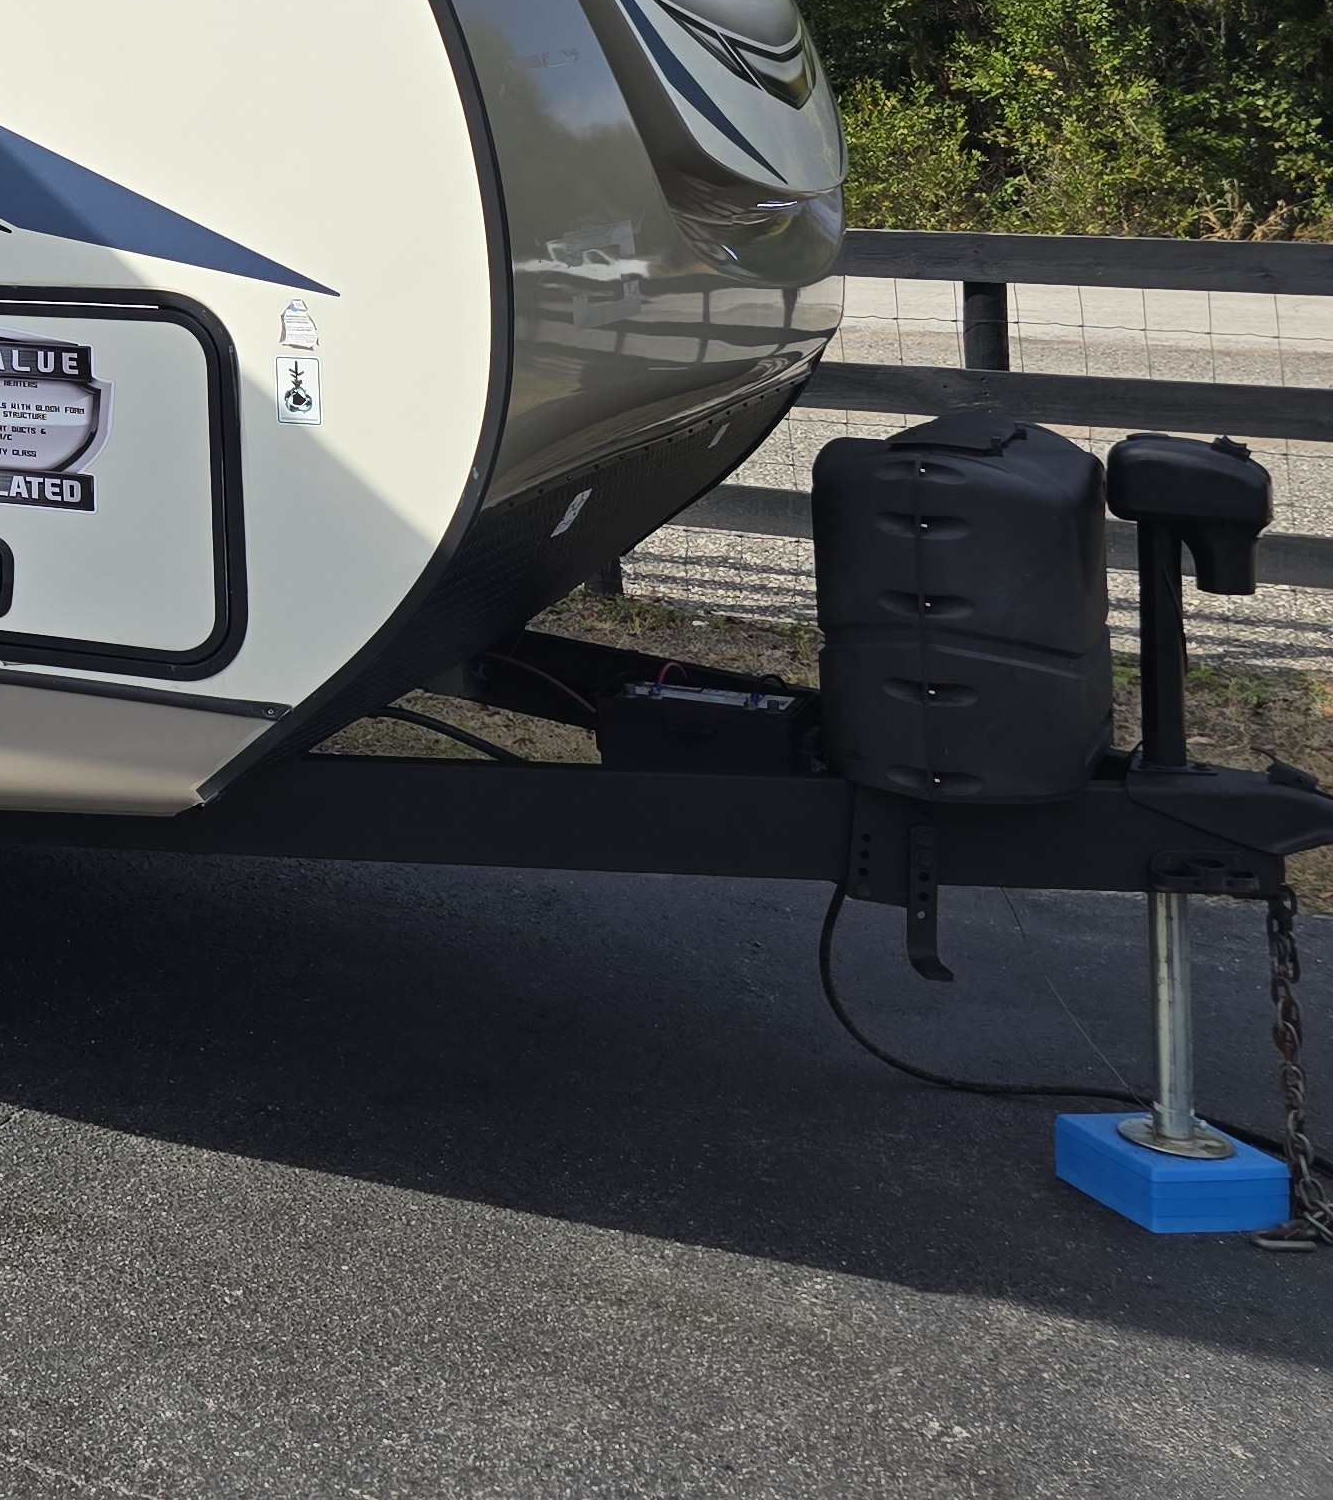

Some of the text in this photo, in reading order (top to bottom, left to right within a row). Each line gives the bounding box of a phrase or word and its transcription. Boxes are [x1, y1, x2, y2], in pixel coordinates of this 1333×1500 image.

[10, 402, 31, 411] WITH
[3, 410, 47, 420] STRUCTURE
[11, 426, 37, 435] DUCTS
